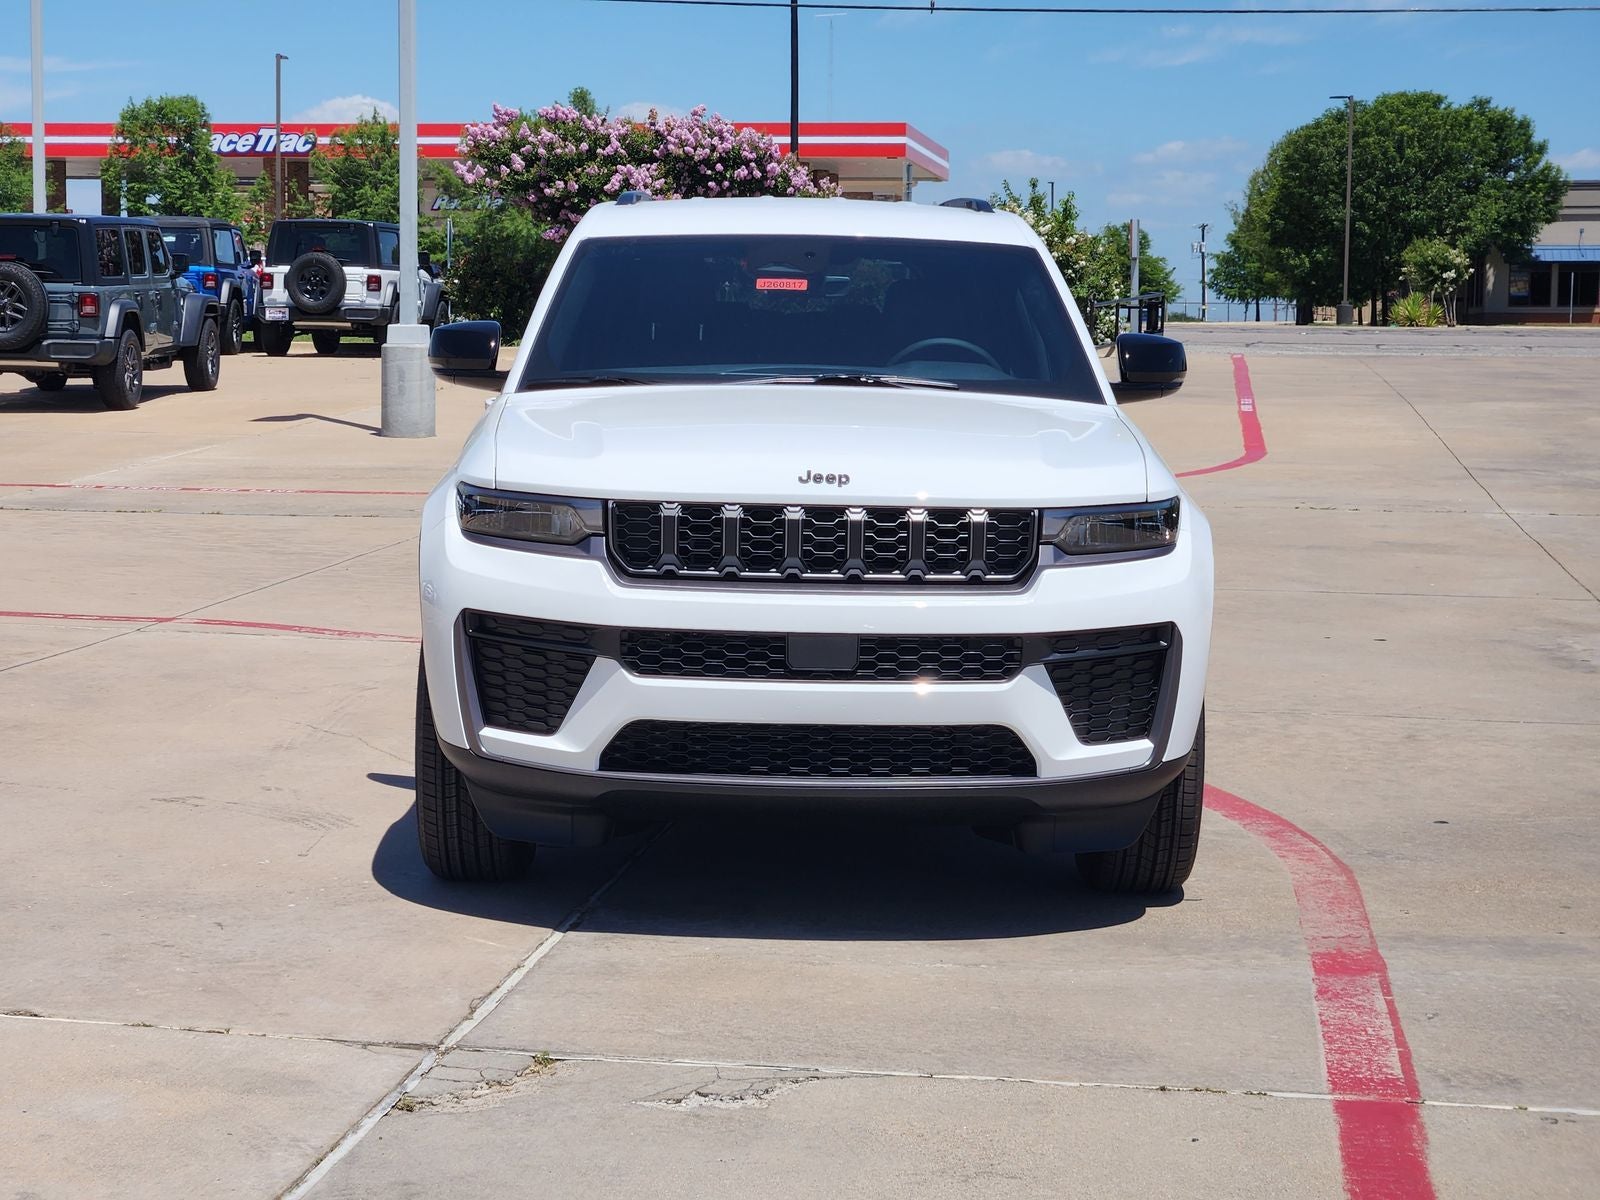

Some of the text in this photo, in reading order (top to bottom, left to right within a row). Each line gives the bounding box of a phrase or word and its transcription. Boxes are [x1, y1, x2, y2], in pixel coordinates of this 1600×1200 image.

[209, 127, 316, 153] aceTrac
[759, 280, 804, 289] J260817
[797, 469, 850, 488] Jeep
